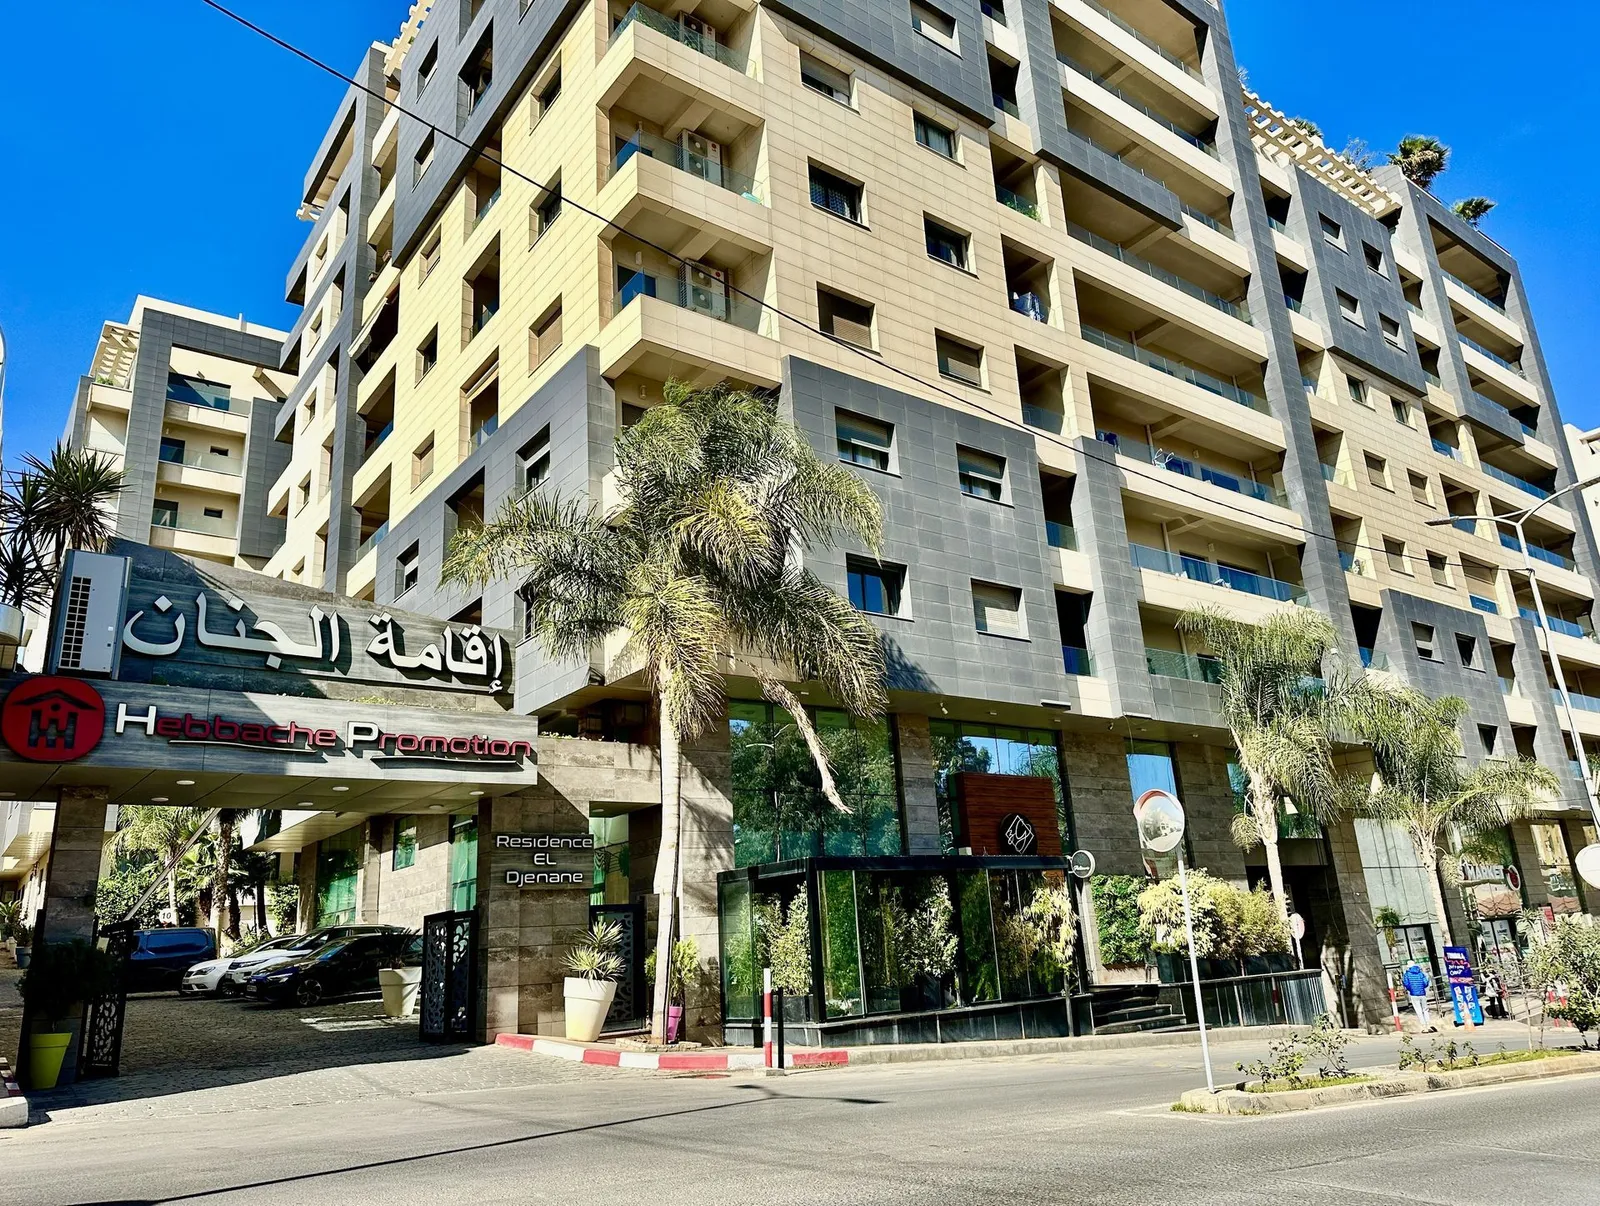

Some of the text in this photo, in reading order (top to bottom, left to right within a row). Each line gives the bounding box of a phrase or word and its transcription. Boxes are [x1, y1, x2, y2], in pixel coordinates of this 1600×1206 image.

[122, 592, 503, 694] إقامة الجنان
[115, 704, 532, 757] Hebbache Promotion
[496, 835, 593, 848] Residence
[533, 853, 556, 865] EL
[506, 871, 583, 888] Djenane
[162, 912, 172, 920] 10
